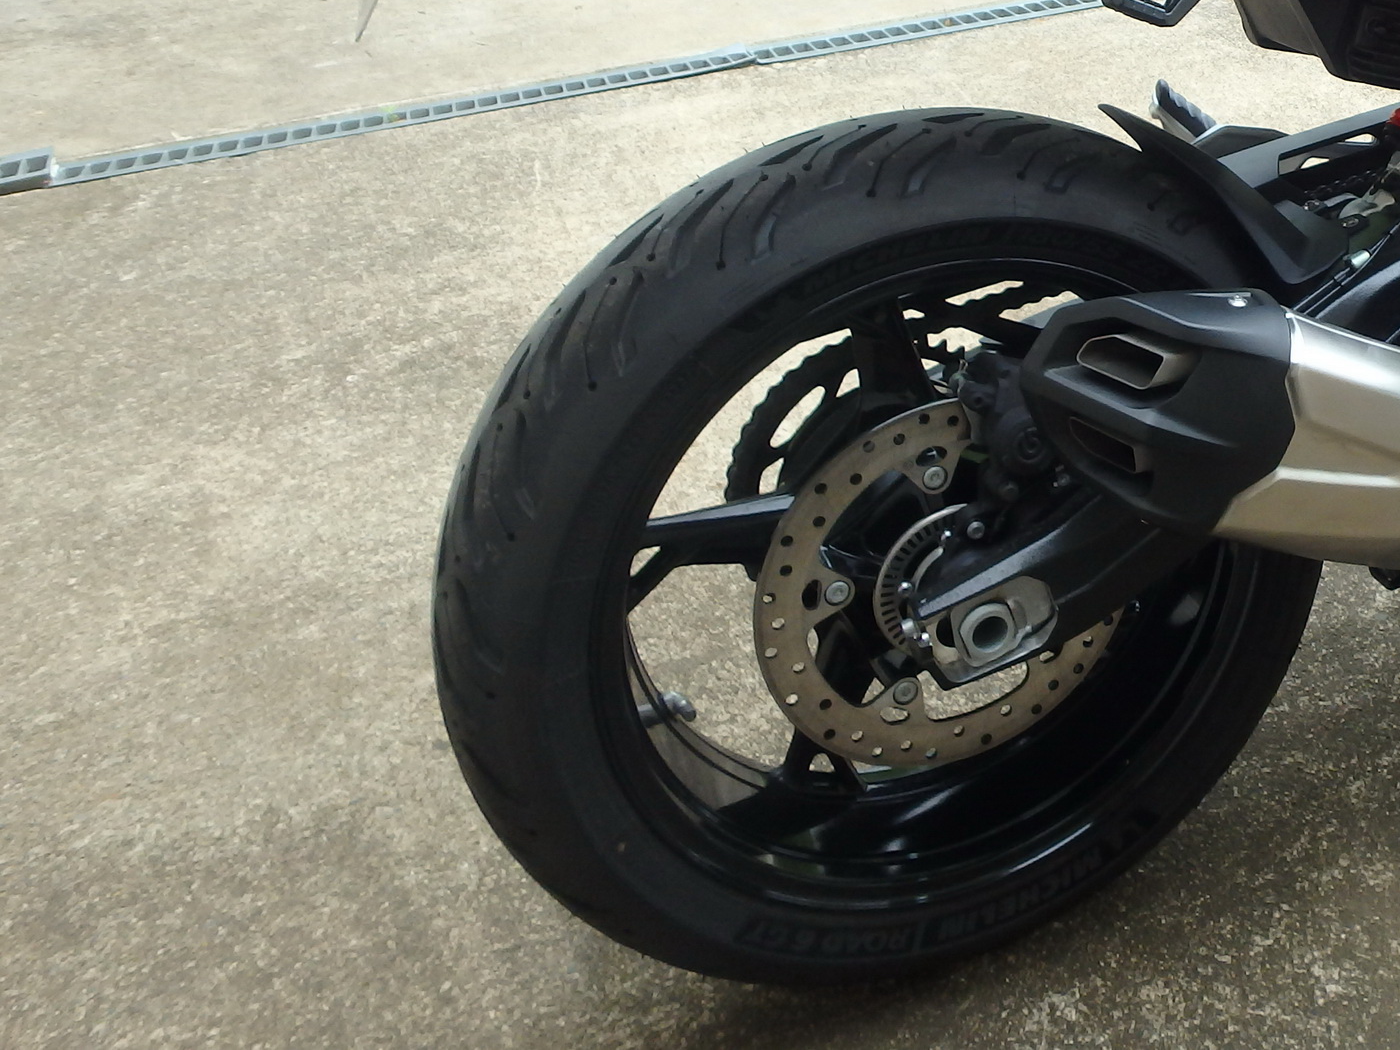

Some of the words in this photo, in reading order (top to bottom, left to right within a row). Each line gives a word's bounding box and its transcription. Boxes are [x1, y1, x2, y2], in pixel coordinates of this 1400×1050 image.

[804, 225, 991, 295] MICHELIN
[936, 851, 1101, 942] MICHELIN
[822, 931, 914, 952] ROAD
